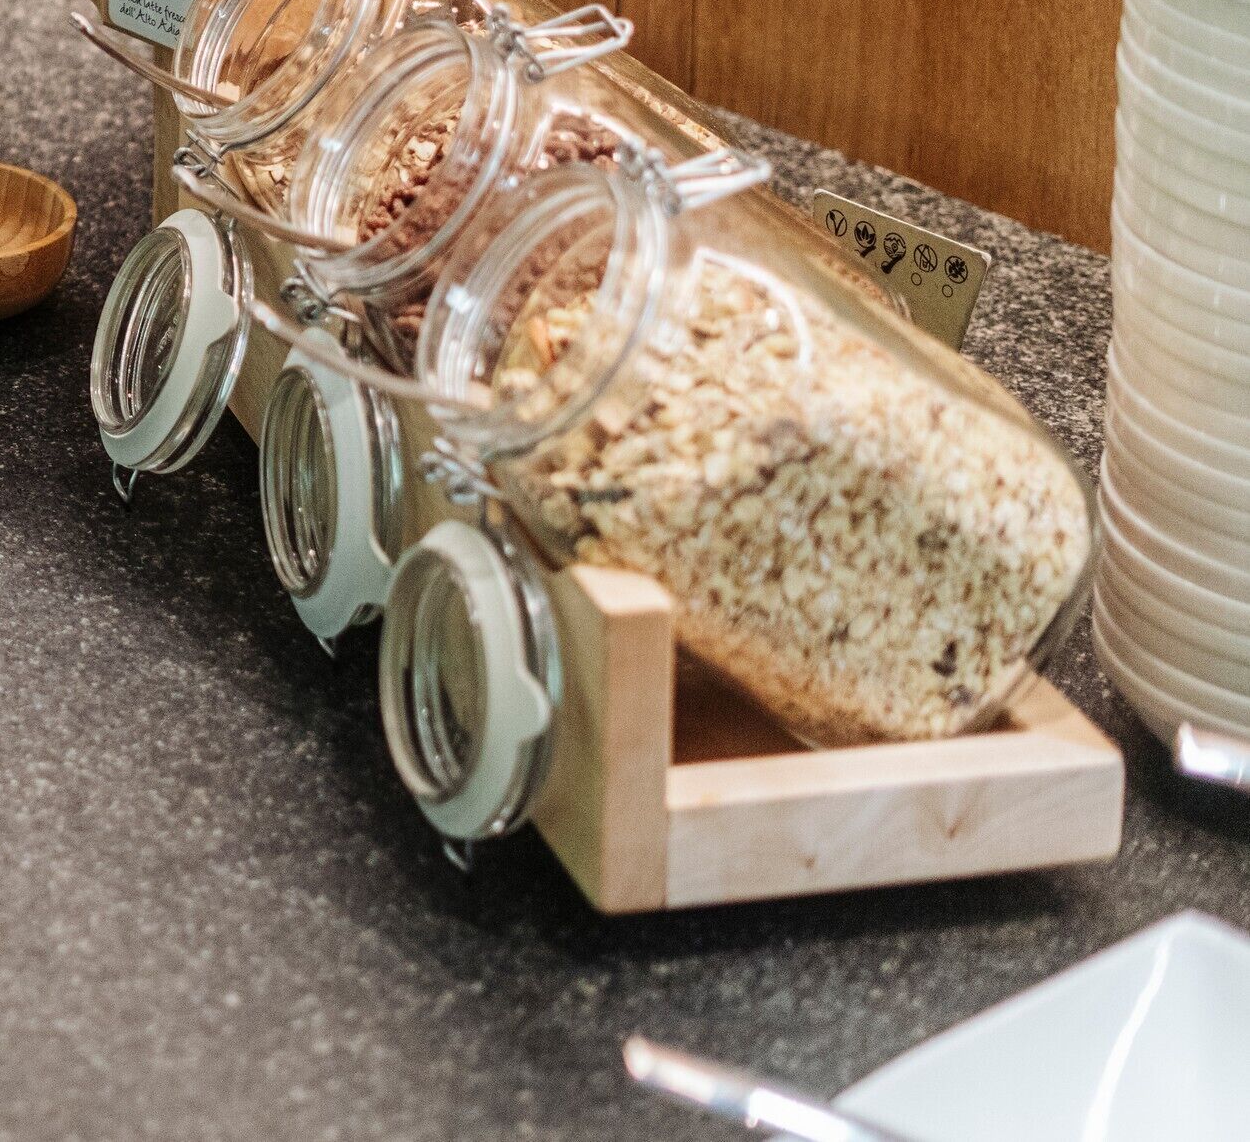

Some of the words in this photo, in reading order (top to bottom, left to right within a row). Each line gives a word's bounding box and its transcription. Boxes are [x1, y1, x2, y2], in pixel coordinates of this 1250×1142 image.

[119, 2, 136, 18] dell'
[135, 8, 157, 27] Alto
[157, 17, 181, 41] Adig
